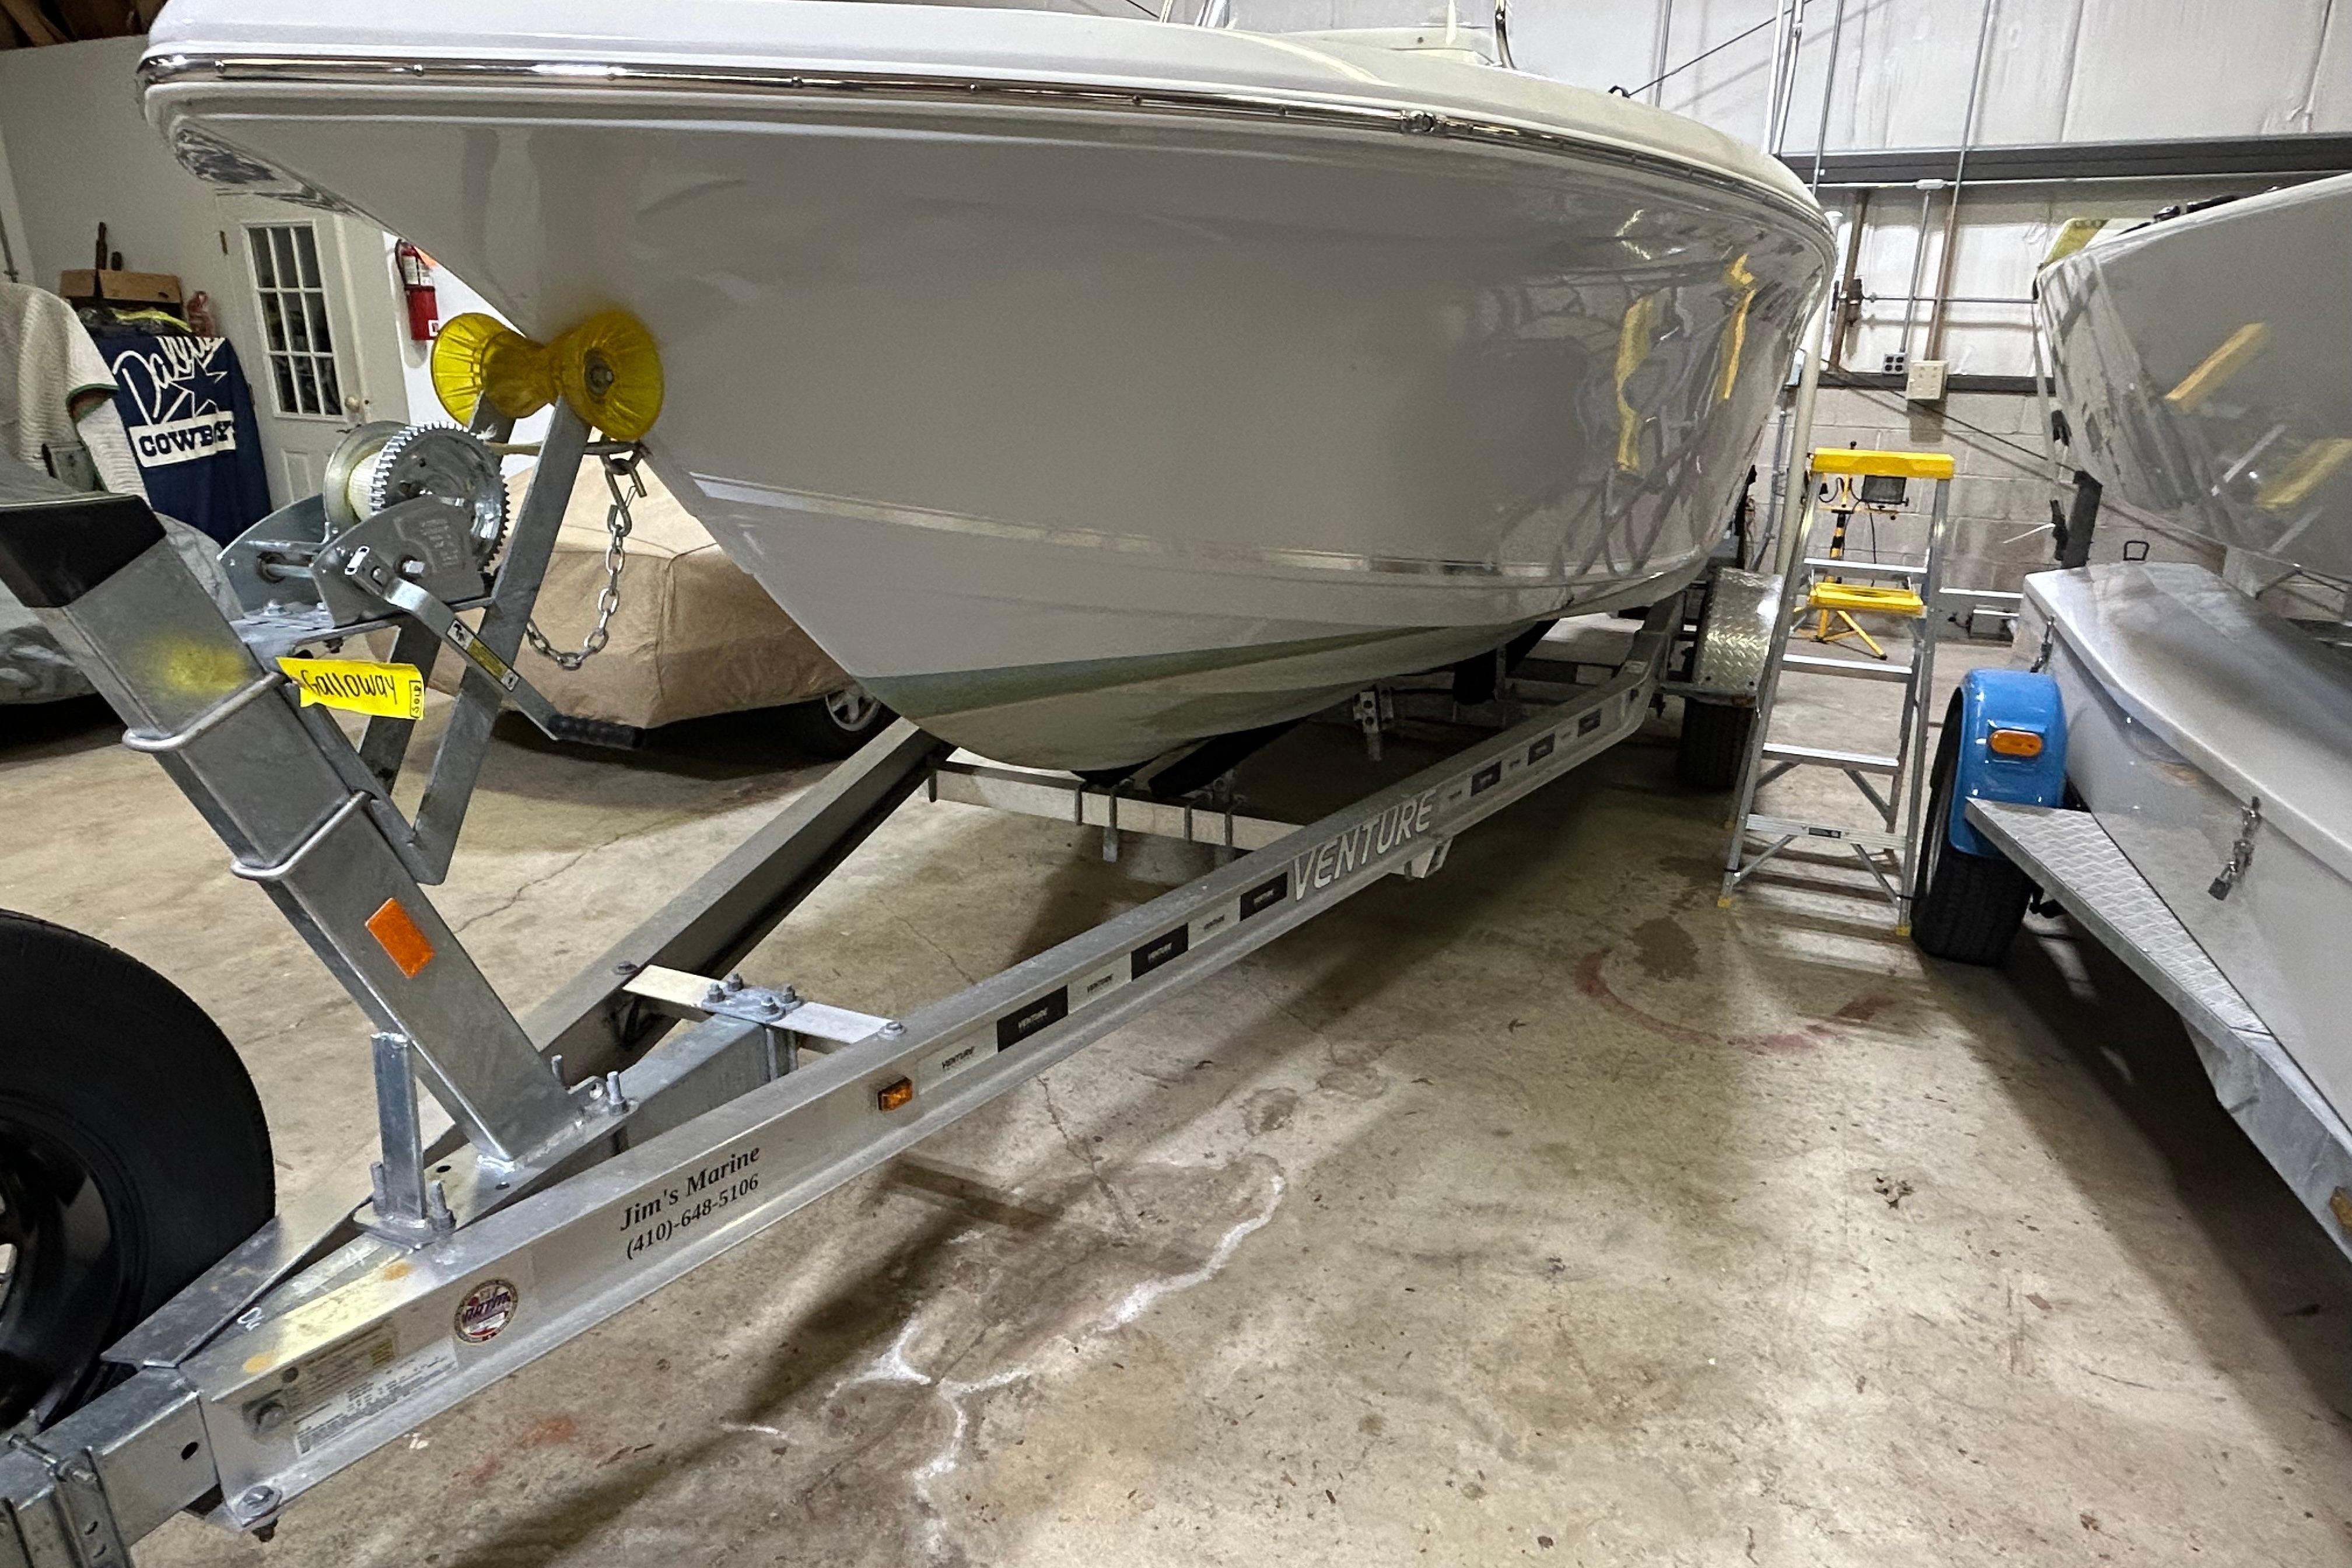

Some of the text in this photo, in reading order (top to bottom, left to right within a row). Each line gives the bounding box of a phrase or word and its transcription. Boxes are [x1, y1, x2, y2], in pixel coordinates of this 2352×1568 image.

[300, 669, 398, 705] Galloway
[1293, 789, 1436, 901] VENTURE
[620, 1147, 761, 1231] Jim's Marine
[626, 1173, 760, 1260] (410)-648-5106
